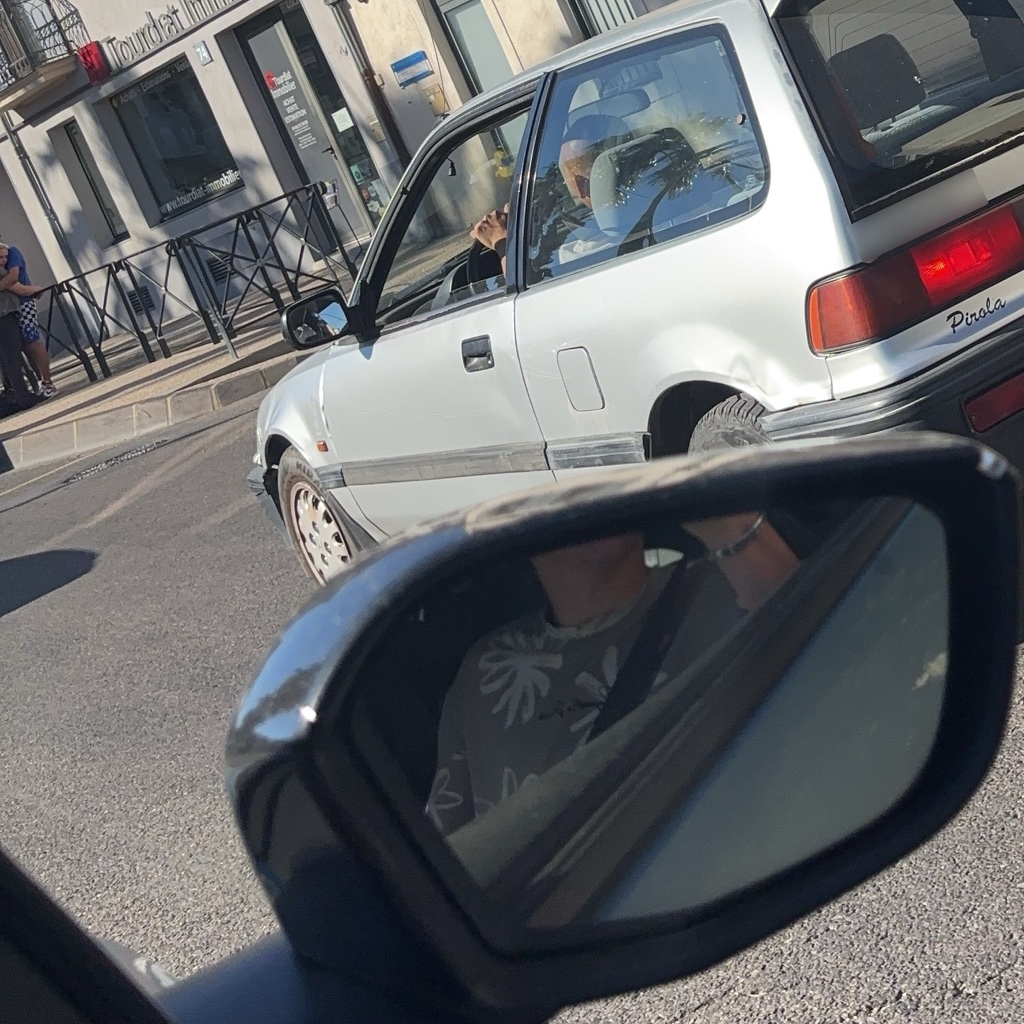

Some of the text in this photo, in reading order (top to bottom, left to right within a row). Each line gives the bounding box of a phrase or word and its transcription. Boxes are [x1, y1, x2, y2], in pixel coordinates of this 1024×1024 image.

[100, 2, 186, 72] Tourdiat
[196, 47, 207, 61] 74
[946, 297, 1007, 334] Pirola
